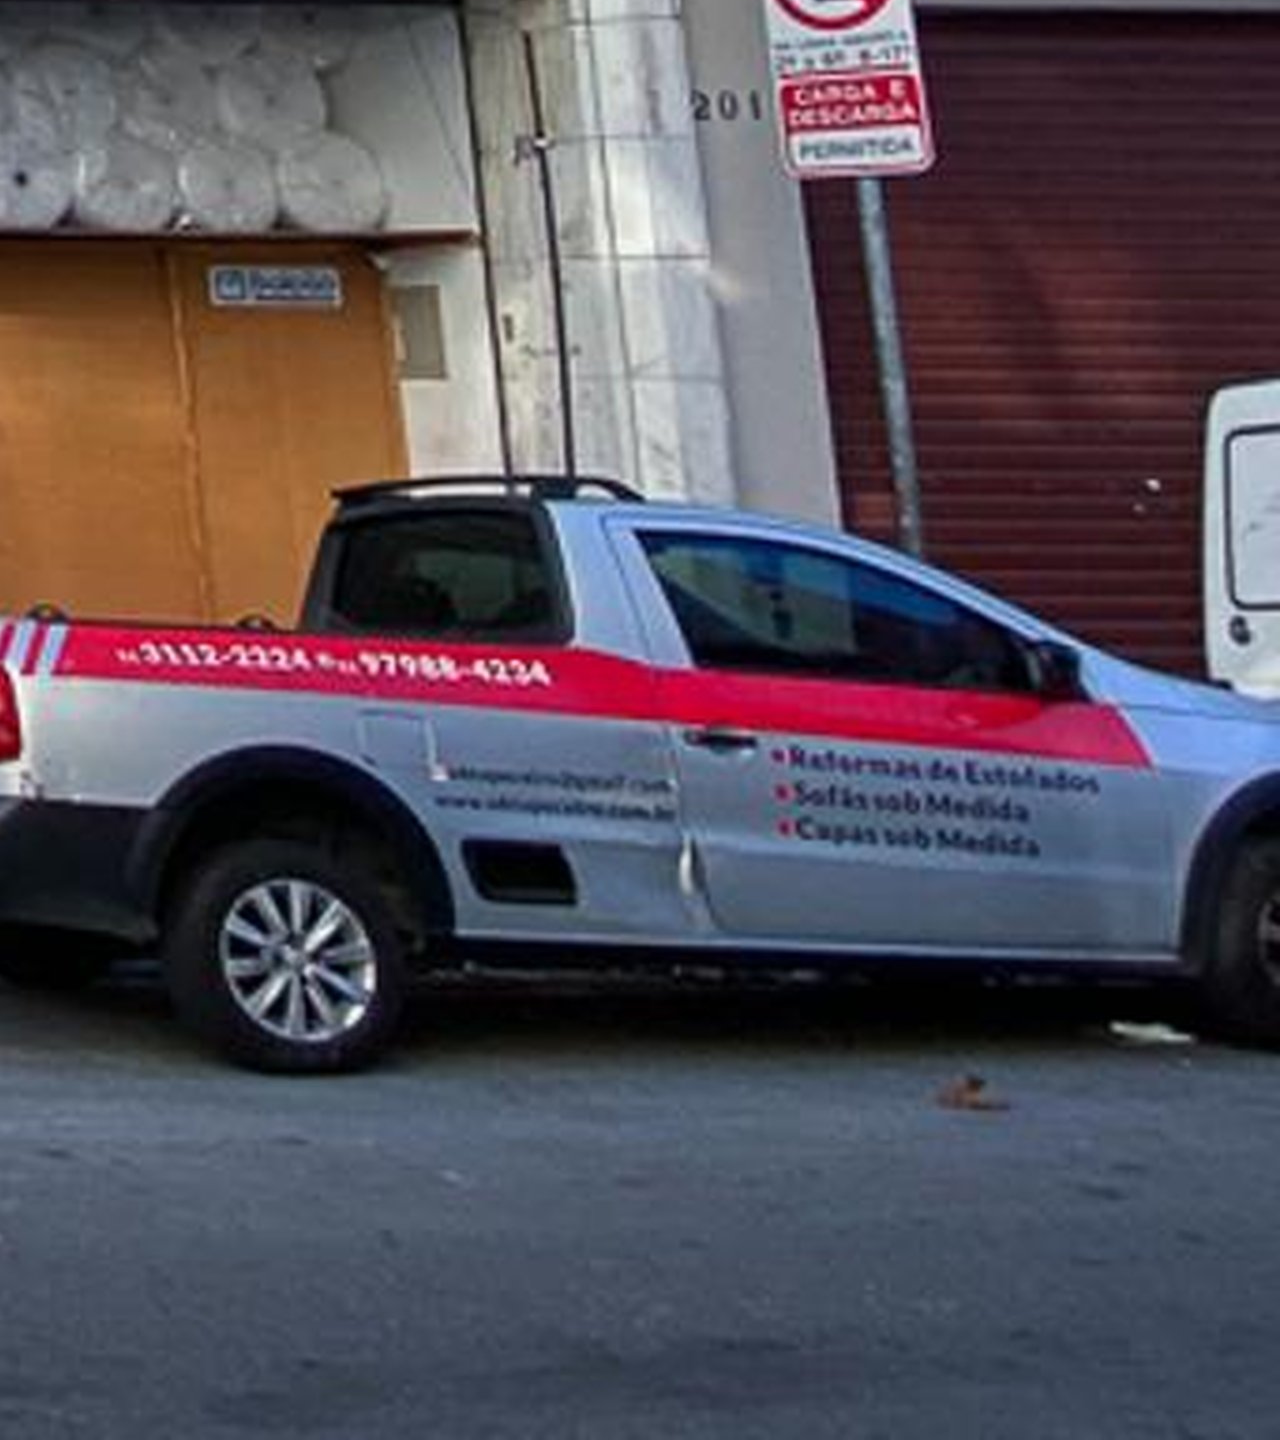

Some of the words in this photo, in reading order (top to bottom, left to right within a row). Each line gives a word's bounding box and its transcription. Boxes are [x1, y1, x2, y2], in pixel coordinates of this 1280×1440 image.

[690, 88, 762, 122] 201
[793, 81, 877, 107] CARGA
[888, 79, 908, 100] E
[788, 99, 918, 128] DESCARGA
[790, 745, 922, 781] Reformas
[929, 758, 960, 783] de
[964, 760, 1102, 795] Estofados
[873, 790, 920, 814] sob
[925, 792, 1032, 824] Medida
[796, 815, 879, 847] Capas
[883, 824, 931, 851] sob
[936, 828, 1041, 859] Medida
